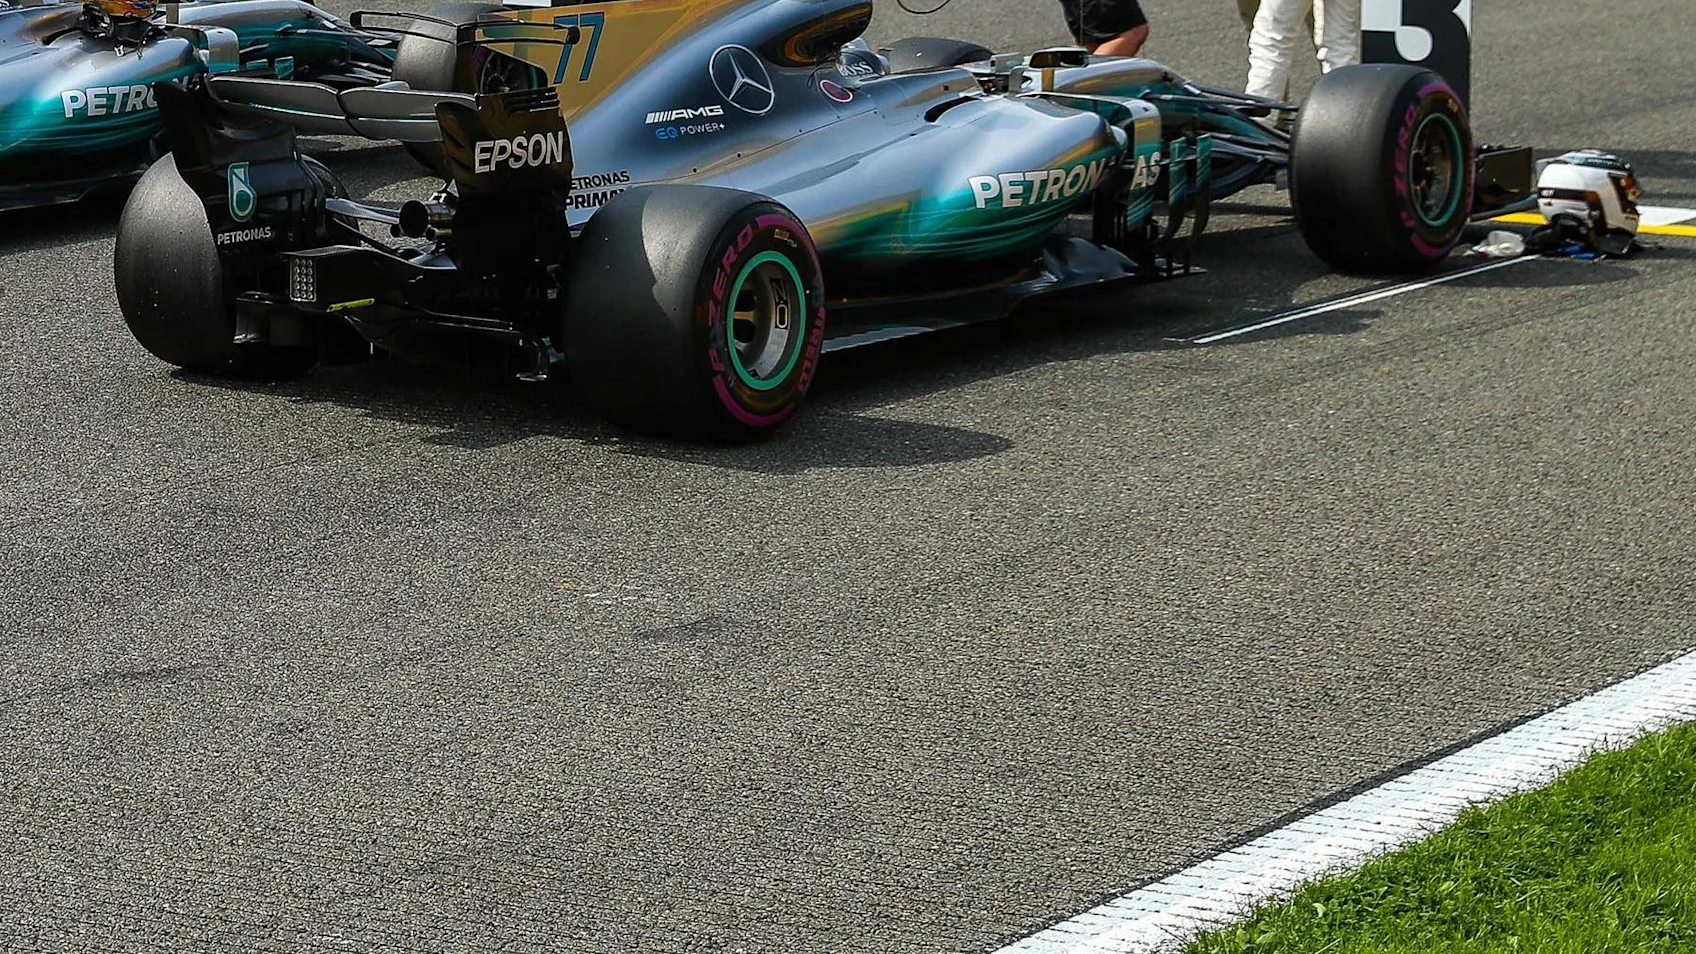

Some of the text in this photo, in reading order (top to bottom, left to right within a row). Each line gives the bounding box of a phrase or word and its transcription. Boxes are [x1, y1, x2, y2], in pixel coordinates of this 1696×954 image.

[554, 12, 604, 84] 77
[670, 106, 725, 121] AMG
[474, 130, 564, 174] EPSON
[569, 170, 630, 191] ETRONAS
[217, 226, 272, 245] PETRONAS
